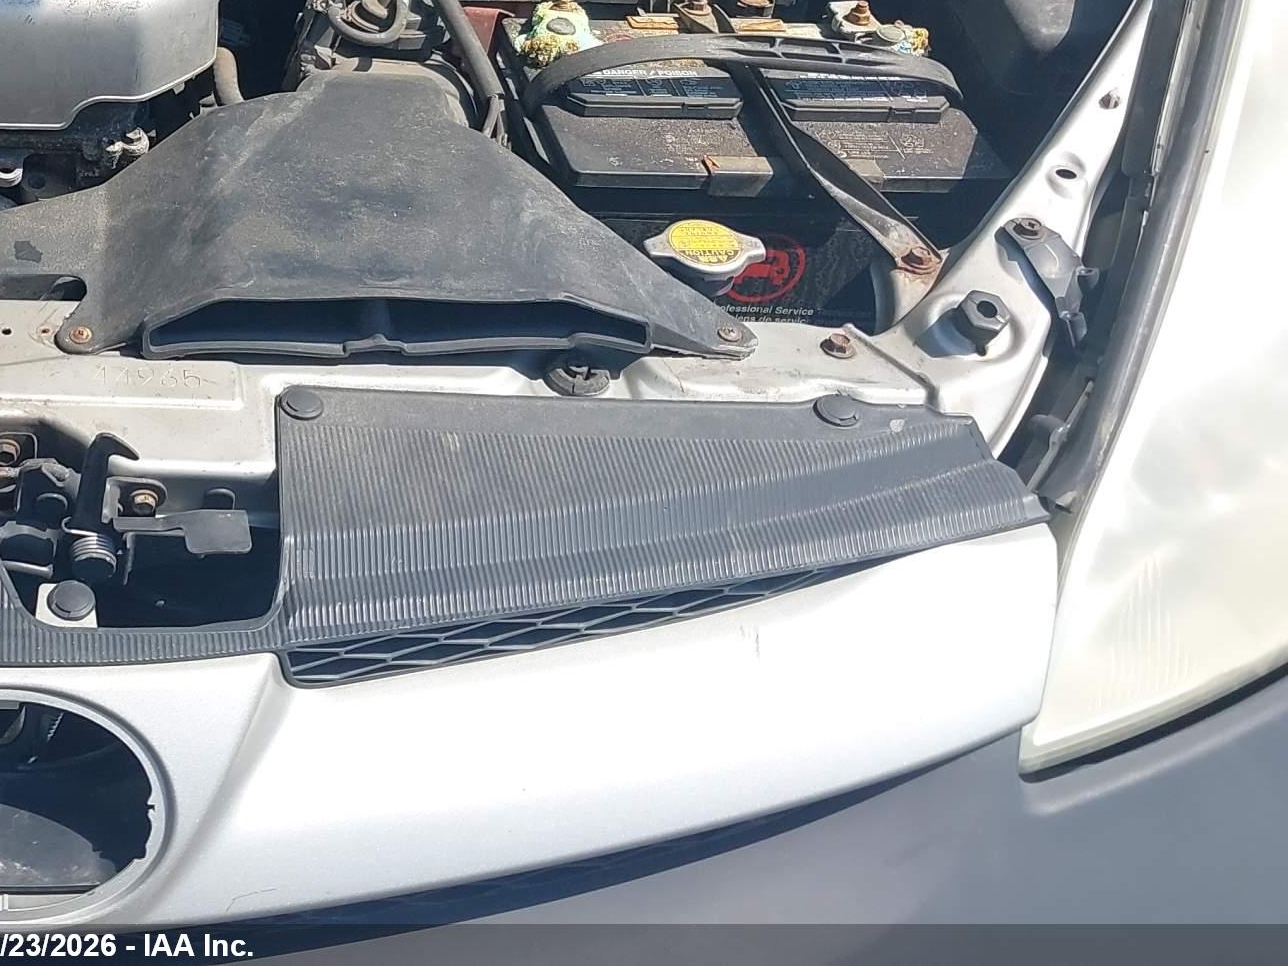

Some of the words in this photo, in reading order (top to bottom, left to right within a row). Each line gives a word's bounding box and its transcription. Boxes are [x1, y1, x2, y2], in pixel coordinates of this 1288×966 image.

[602, 68, 648, 77] DANGER
[657, 69, 699, 77] POISON
[719, 304, 773, 314] ofessional
[775, 306, 814, 316] Service
